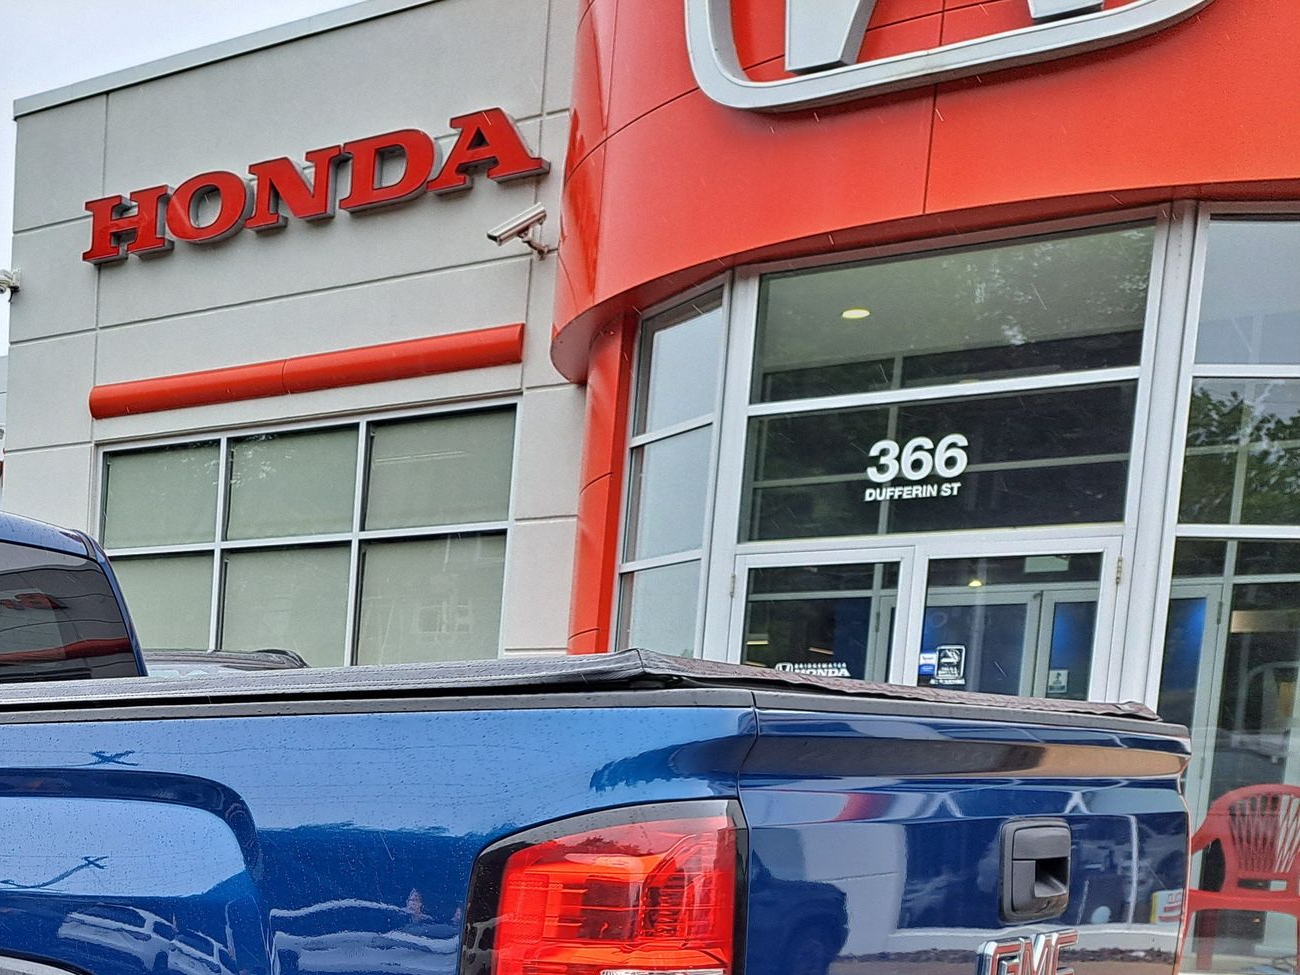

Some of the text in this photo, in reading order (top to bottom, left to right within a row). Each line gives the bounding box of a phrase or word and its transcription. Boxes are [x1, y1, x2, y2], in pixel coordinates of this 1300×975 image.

[82, 106, 550, 265] HONDA
[867, 433, 969, 484] 366
[864, 482, 961, 502] DUFFERIN ST
